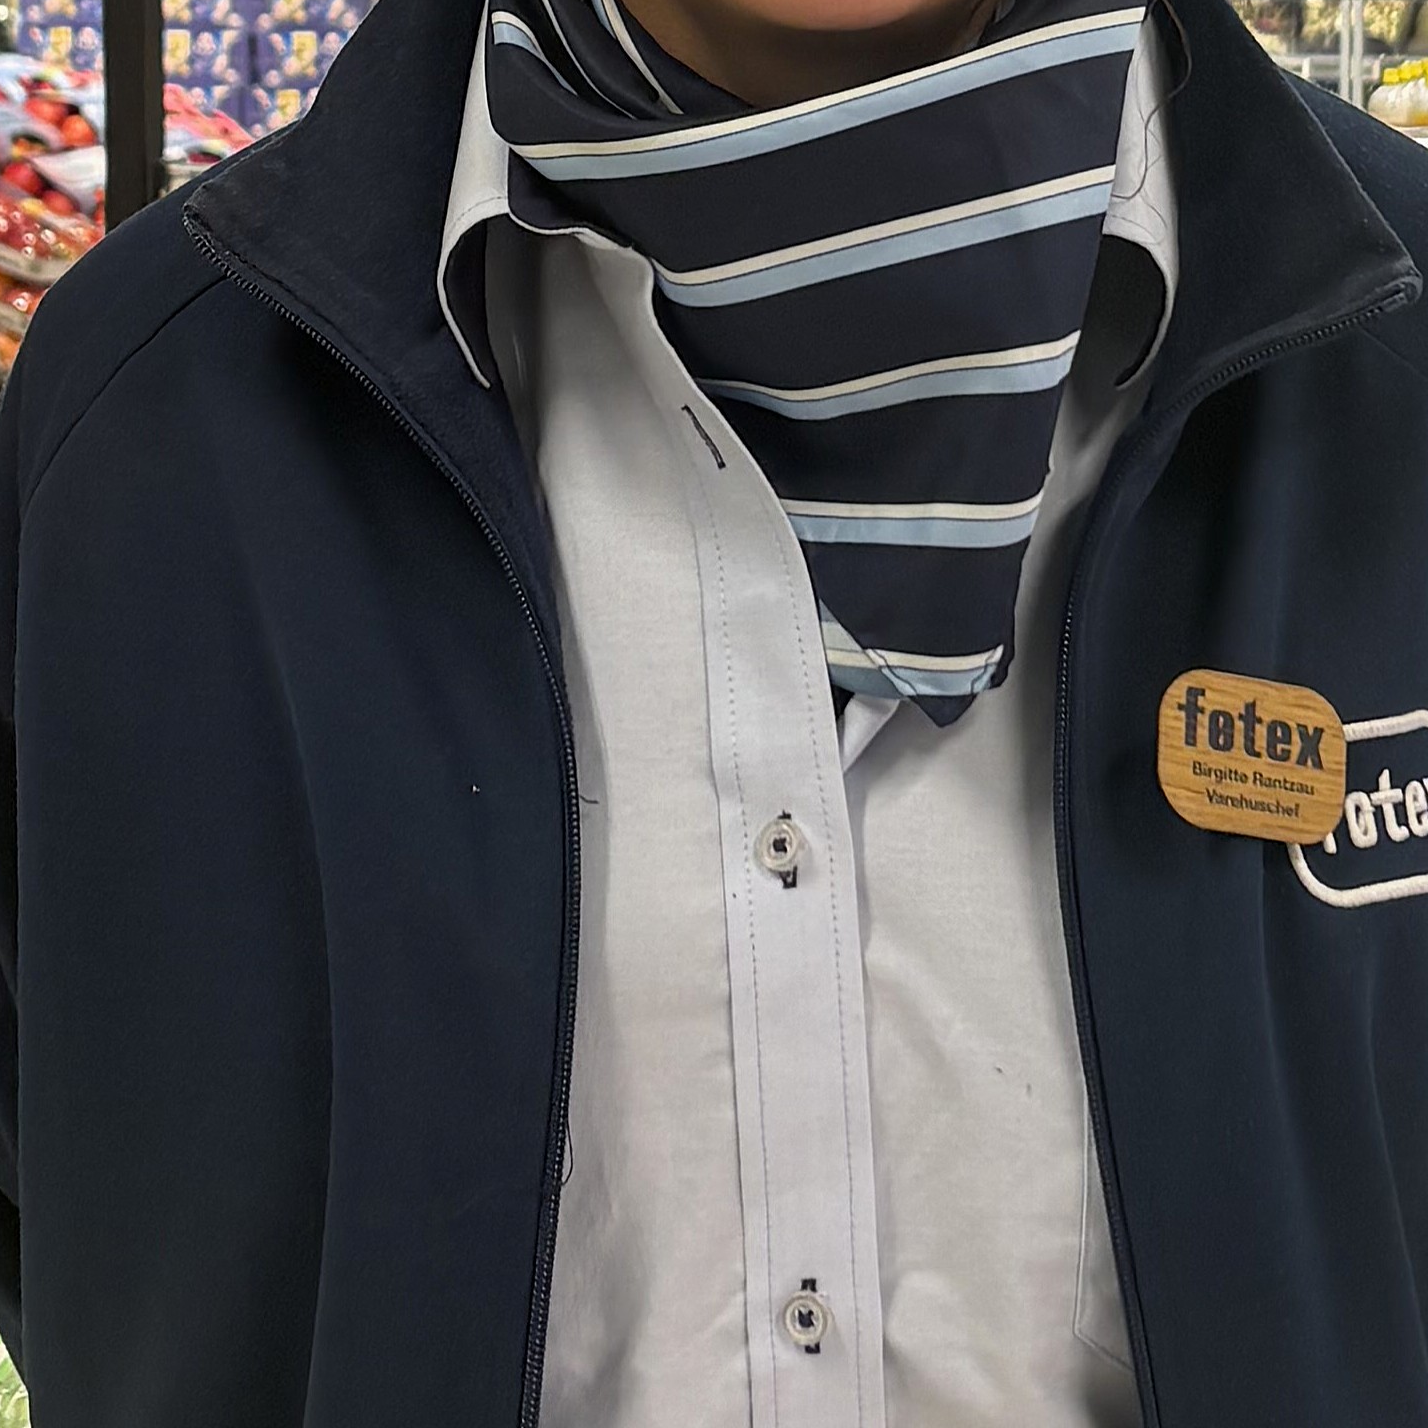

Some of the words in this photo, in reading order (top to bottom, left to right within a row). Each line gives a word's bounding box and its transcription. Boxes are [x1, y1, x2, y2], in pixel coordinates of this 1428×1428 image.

[1177, 685, 1325, 771] føtex
[1191, 760, 1249, 786] Birgitte
[1252, 769, 1315, 796] Rantzau
[1204, 787, 1300, 819] Varehuschef
